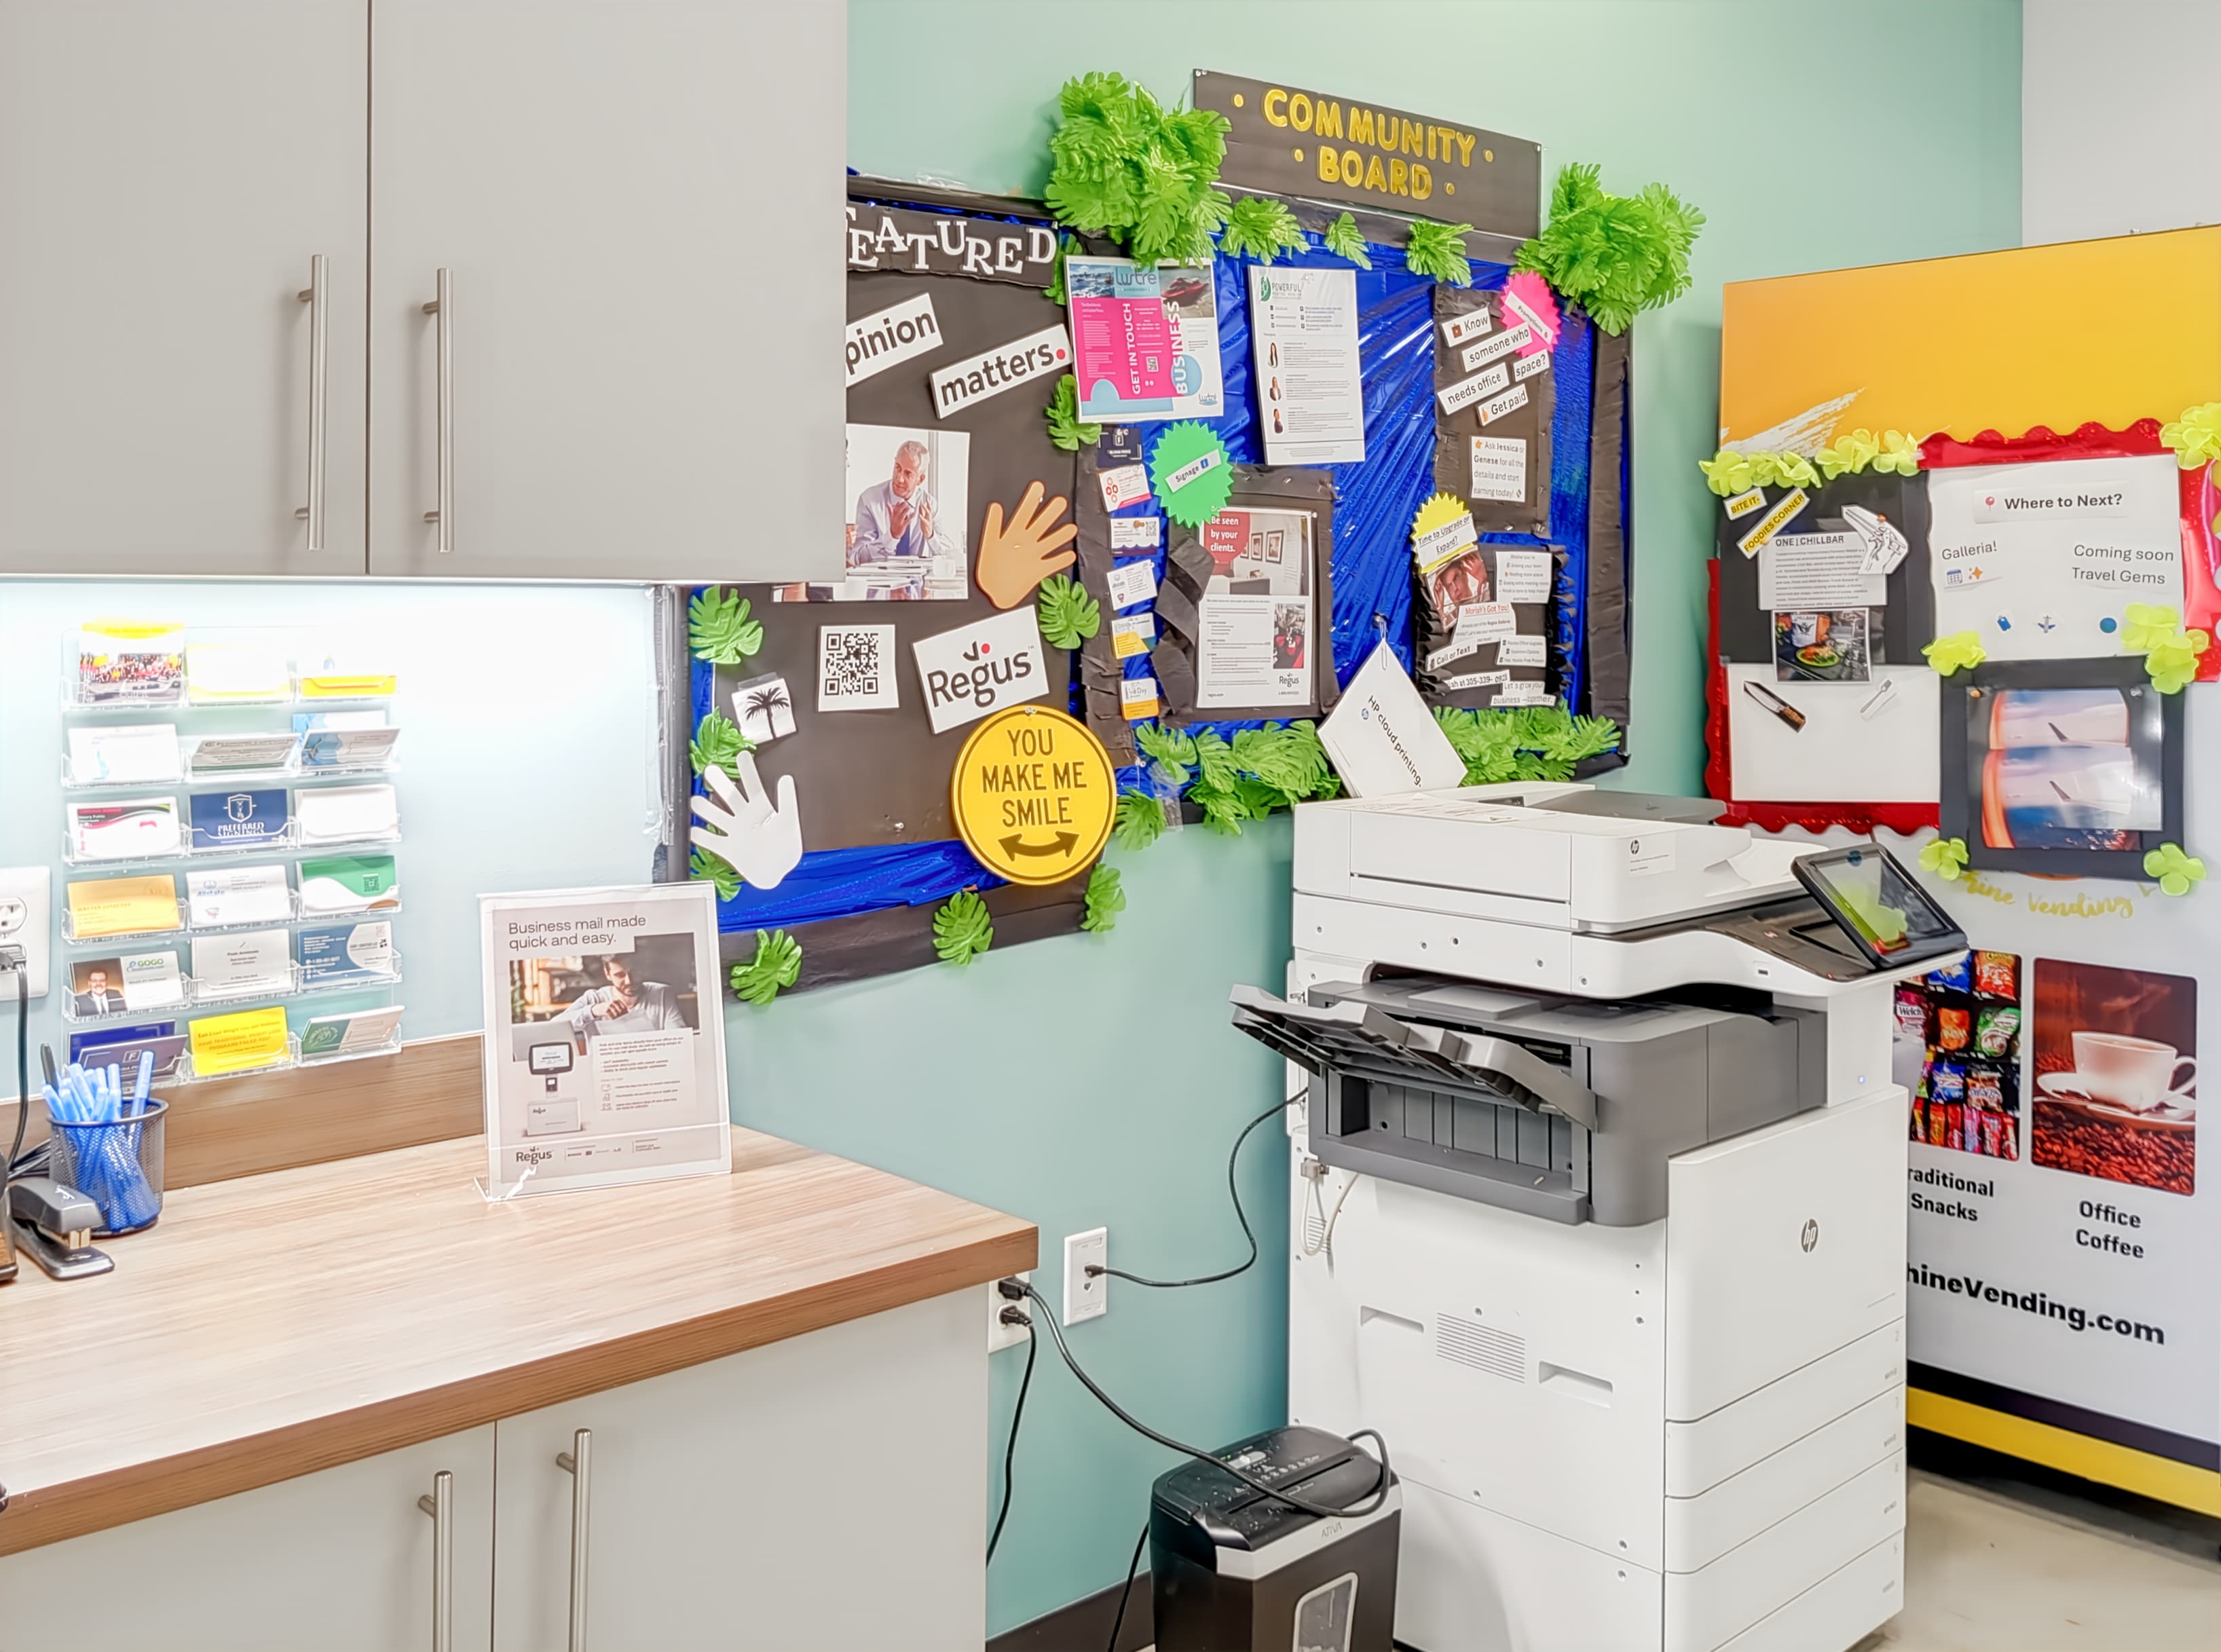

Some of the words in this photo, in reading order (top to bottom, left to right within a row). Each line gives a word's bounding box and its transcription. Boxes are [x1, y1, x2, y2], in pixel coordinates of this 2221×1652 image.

[1263, 89, 1476, 167] COMMUNITY
[1318, 146, 1432, 200] BOARD
[1123, 303, 1135, 350] TOUCH
[1464, 316, 1488, 332] Know
[1168, 301, 1188, 394] BUSINESS
[1470, 337, 1510, 362] someone
[1511, 328, 1529, 343] who
[1128, 352, 1138, 366] IN
[1516, 354, 1546, 377] space?
[941, 343, 1066, 407] matters.
[1130, 369, 1140, 394] GET
[1448, 384, 1476, 404] needs
[1478, 373, 1501, 390] office
[1491, 402, 1507, 415] Get
[1508, 390, 1526, 410] paid
[1485, 441, 1496, 449] Ask
[1175, 465, 1199, 482] Signage
[1474, 470, 1494, 479] details
[1495, 472, 1506, 481] and
[1473, 488, 1495, 497] earning
[2004, 496, 2053, 510] Where
[2057, 496, 2073, 508] to
[2077, 493, 2123, 506] Next?
[1731, 500, 1749, 514] BITE
[1211, 516, 1221, 525] Be
[1221, 517, 1239, 525] seen
[1744, 521, 1774, 552] FOODIES
[1773, 494, 1804, 524] CORNER
[1210, 529, 1220, 539] by
[1220, 532, 1238, 540] your
[1775, 538, 1794, 546] ONE
[1799, 535, 1844, 545] CHILLBAR
[1210, 542, 1236, 552] clients.
[1941, 540, 1998, 561] Galleria!
[2074, 544, 2132, 562] Coming
[2135, 550, 2174, 562] soon
[2072, 567, 2116, 582] Travel
[2119, 569, 2166, 584] Gems
[1436, 654, 1449, 664] Call
[1457, 645, 1470, 656] Text
[927, 646, 1032, 708] Regus
[1279, 674, 1299, 688] Regus
[1493, 696, 1520, 705] business
[1007, 728, 1053, 756] YOU
[1368, 695, 1380, 712] HP
[1378, 714, 1398, 743] cloud
[1394, 743, 1421, 787] printing.
[982, 763, 1047, 793] MAKE
[1053, 762, 1087, 789] ME
[1002, 797, 1072, 827] SMILE
[2028, 891, 2134, 919] Vending
[509, 920, 572, 935] Business
[576, 917, 603, 931] mail
[607, 914, 646, 928] made
[509, 935, 548, 952] quick
[551, 933, 578, 946] and
[582, 933, 616, 945] easy.
[138, 958, 164, 967] GOGO
[516, 1148, 553, 1165] Regus
[1911, 1193, 1978, 1222] Snacks
[2079, 1200, 2141, 1228] Office
[2076, 1228, 2144, 1258] Coffee
